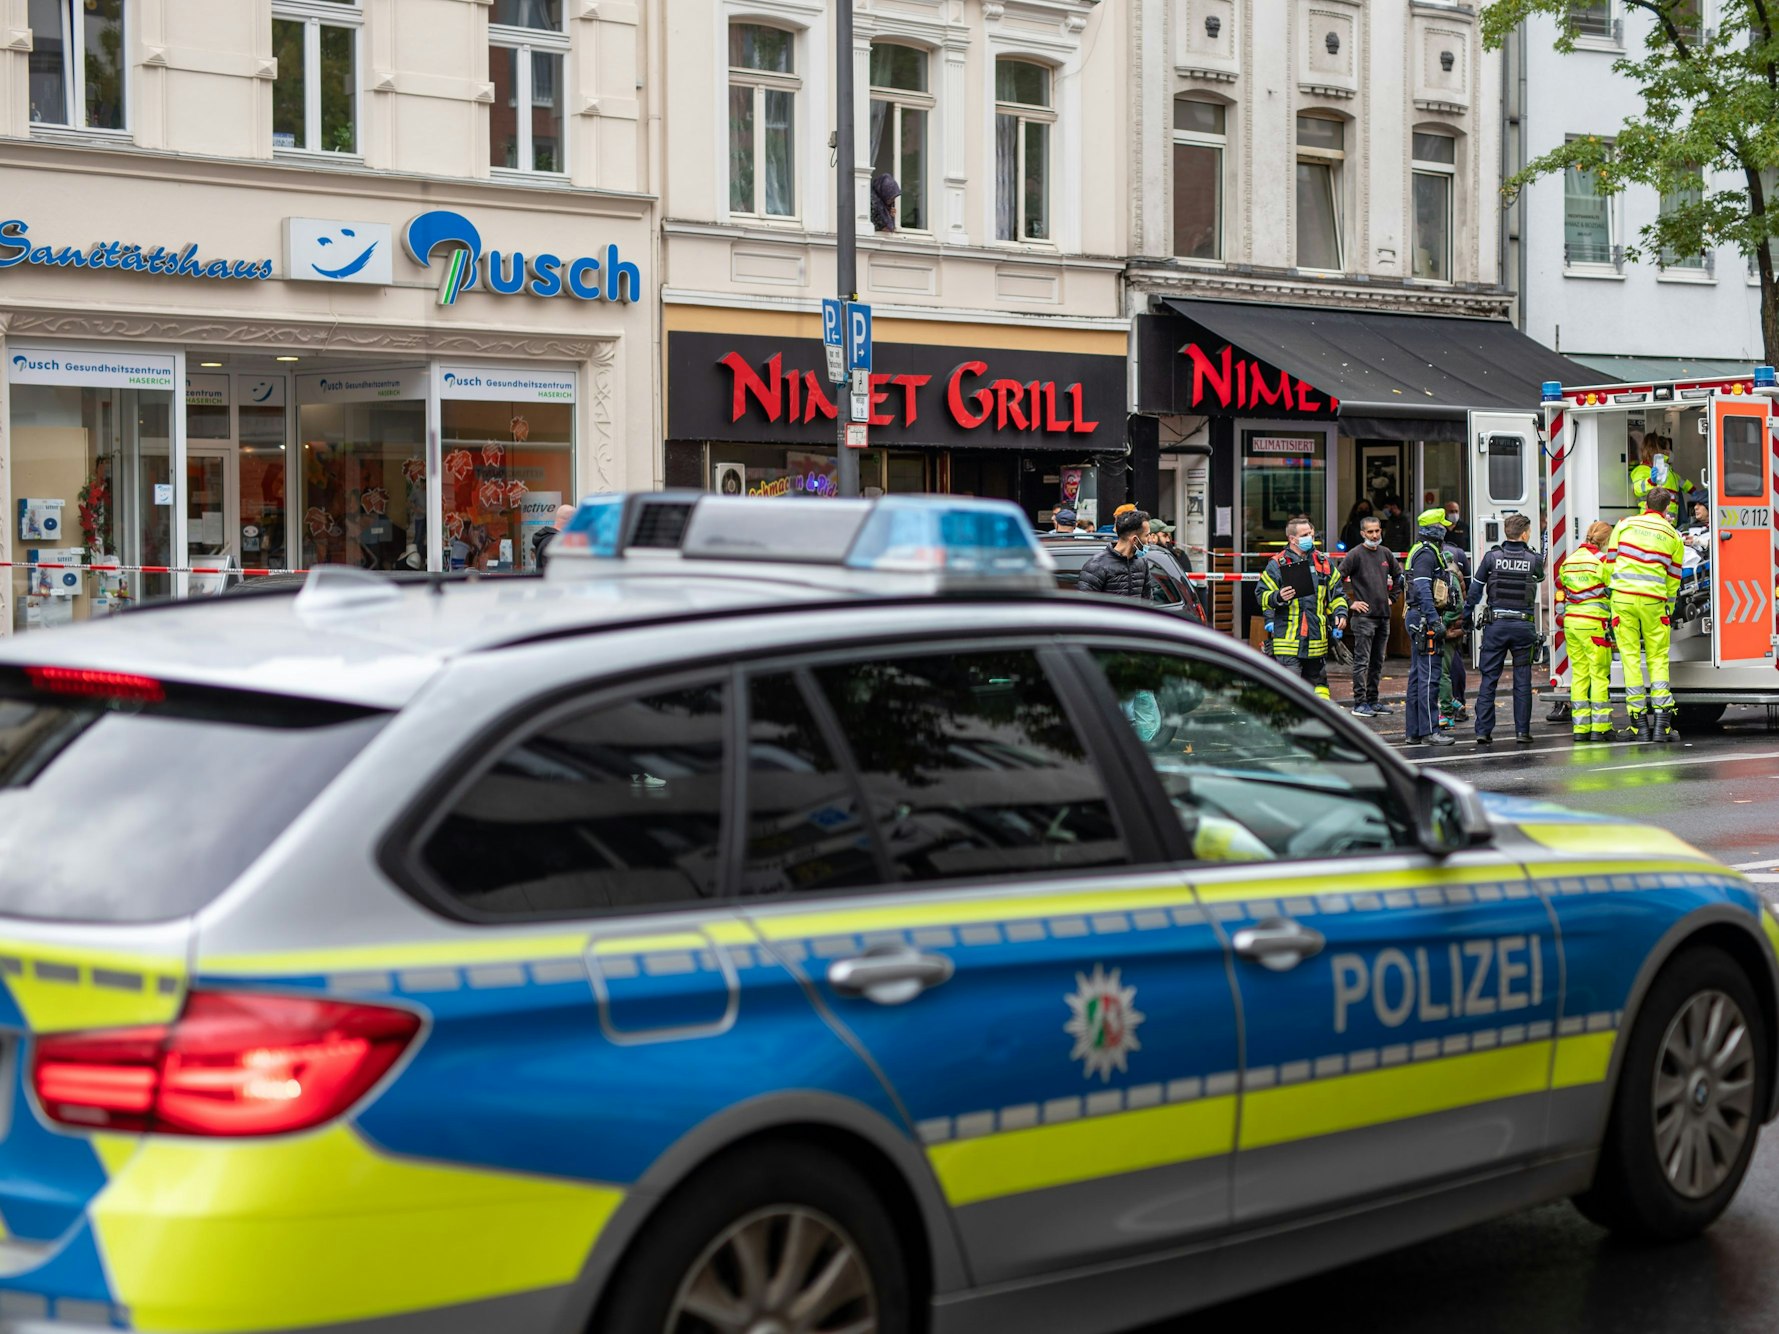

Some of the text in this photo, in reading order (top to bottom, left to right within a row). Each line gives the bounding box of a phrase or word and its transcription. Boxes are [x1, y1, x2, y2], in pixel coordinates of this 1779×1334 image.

[0, 219, 273, 280] Sanitätshaus
[825, 304, 836, 342] P
[852, 311, 866, 363] P
[65, 362, 171, 375] Gesundheitszentrum
[129, 376, 171, 385] HASERICH
[486, 379, 572, 389] Gesundheitszentrum
[945, 360, 1100, 434] GRILL
[1253, 439, 1314, 451] KLIMATISIERT
[522, 503, 556, 513] active
[1752, 509, 1768, 526] 112
[1495, 559, 1531, 572] POLIZEI
[1331, 934, 1543, 1034] POLIZEI
